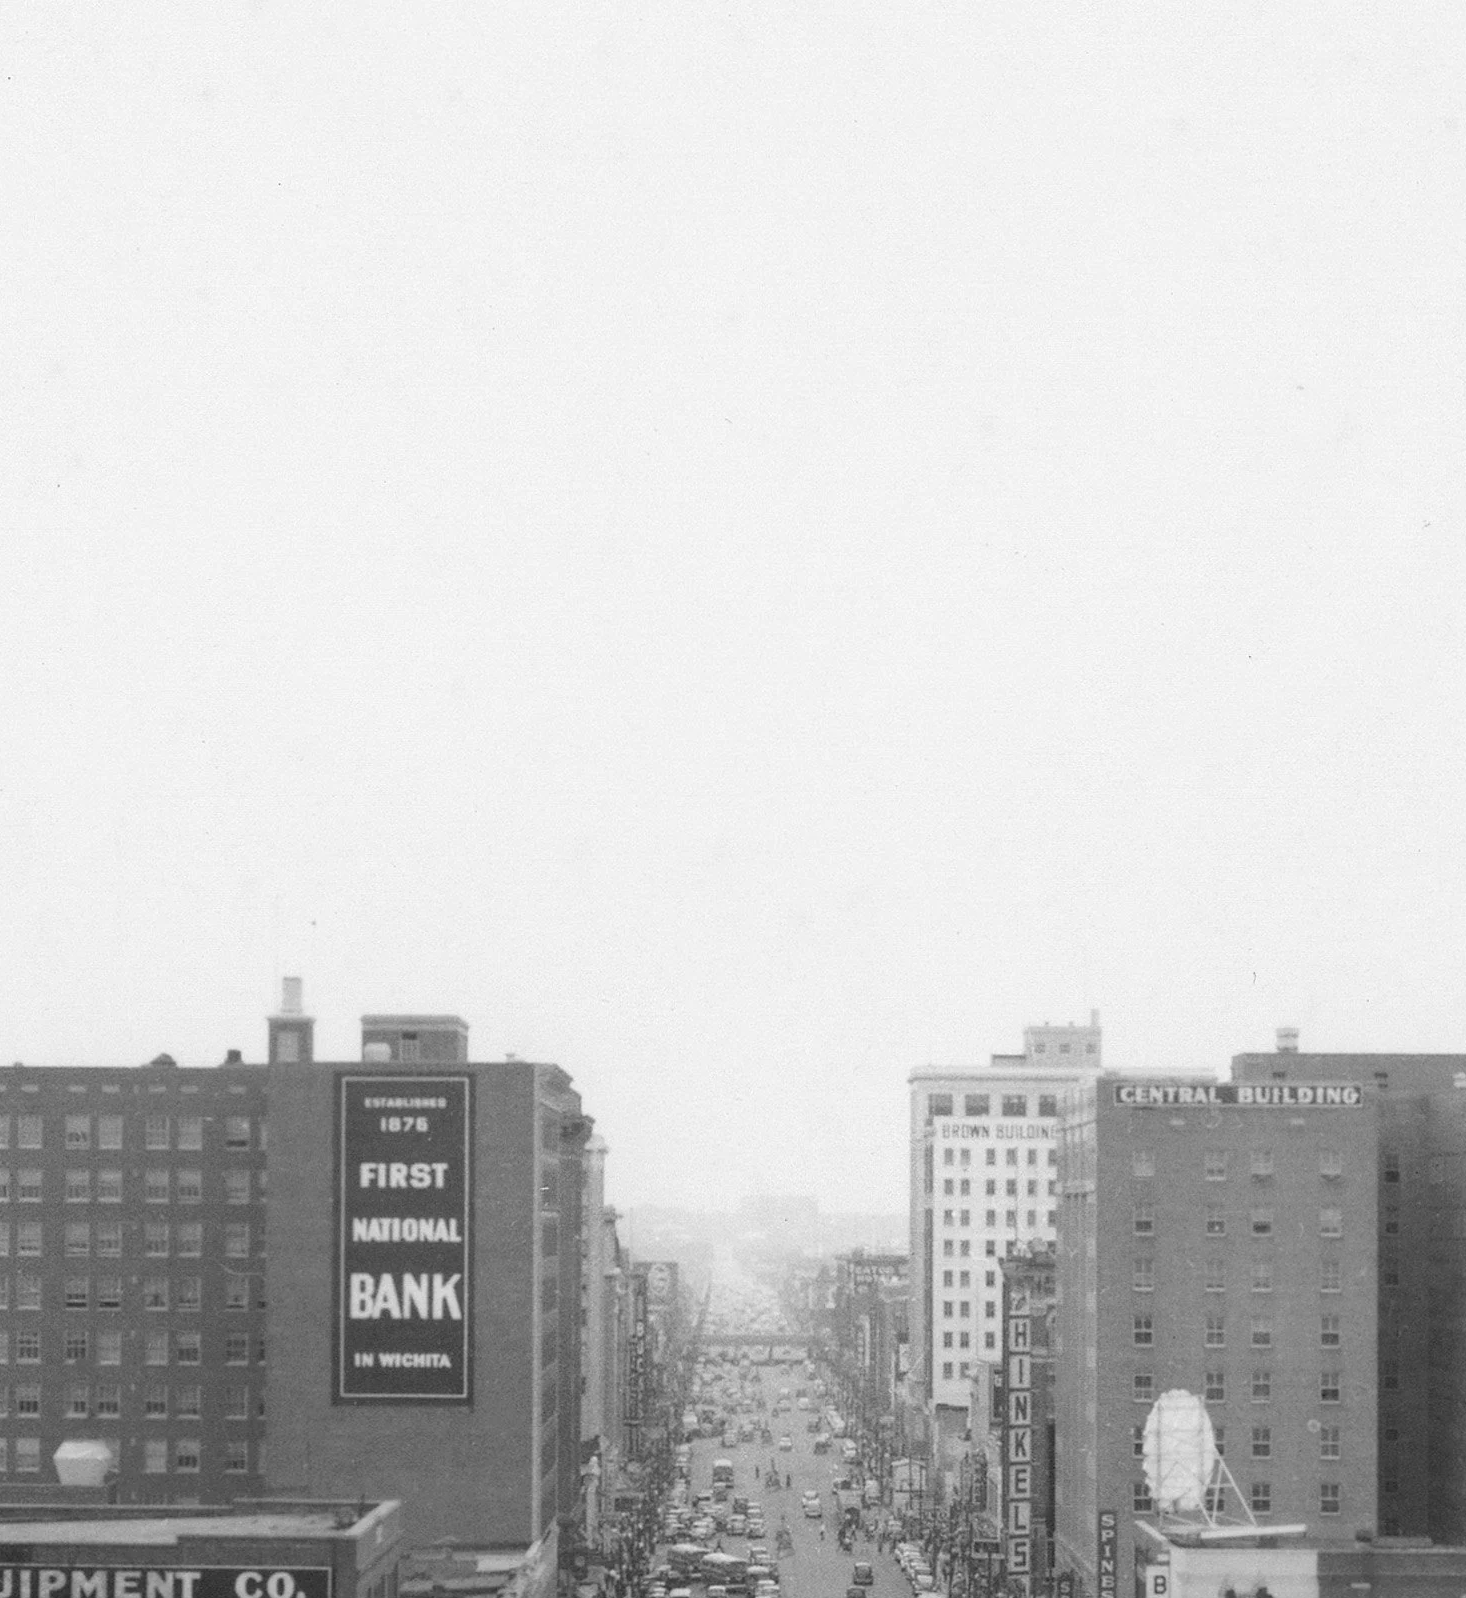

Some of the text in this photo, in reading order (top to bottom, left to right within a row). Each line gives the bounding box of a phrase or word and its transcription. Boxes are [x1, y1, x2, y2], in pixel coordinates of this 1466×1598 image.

[1120, 1087, 1361, 1105] CENTRAL BUILDING
[941, 1123, 991, 1140] BROWN
[360, 1162, 449, 1189] FIRST
[352, 1217, 463, 1243] NATIONAL
[350, 1272, 463, 1321] BANK
[354, 1352, 453, 1369] IN WICHITA
[1013, 1322, 1028, 1568] HINKELS
